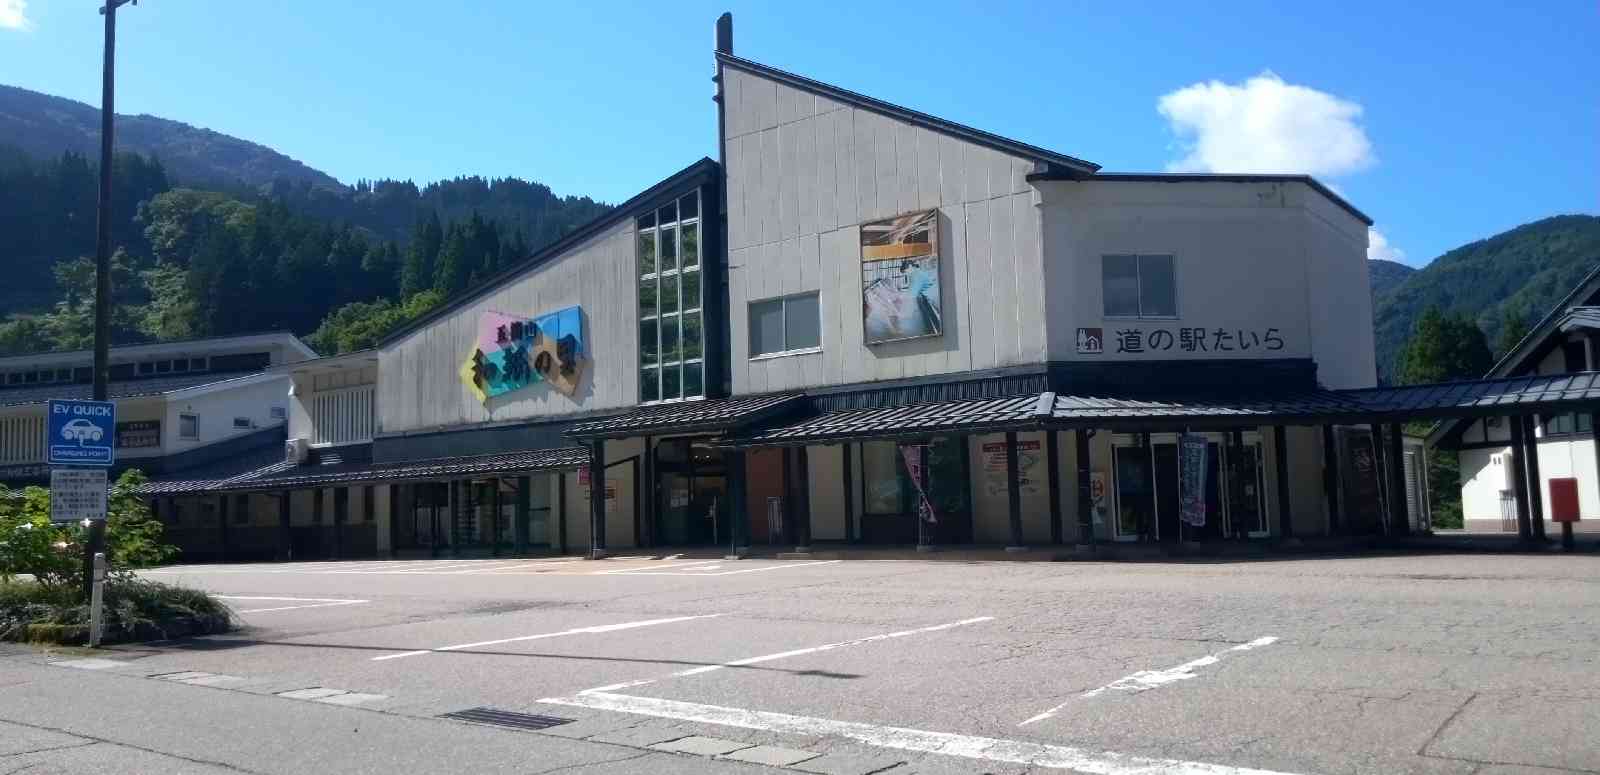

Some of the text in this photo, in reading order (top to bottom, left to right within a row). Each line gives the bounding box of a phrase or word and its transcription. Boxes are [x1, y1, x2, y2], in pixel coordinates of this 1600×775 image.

[1116, 327, 1285, 353] 道の駅たいら
[53, 404, 111, 417] EV QUICK
